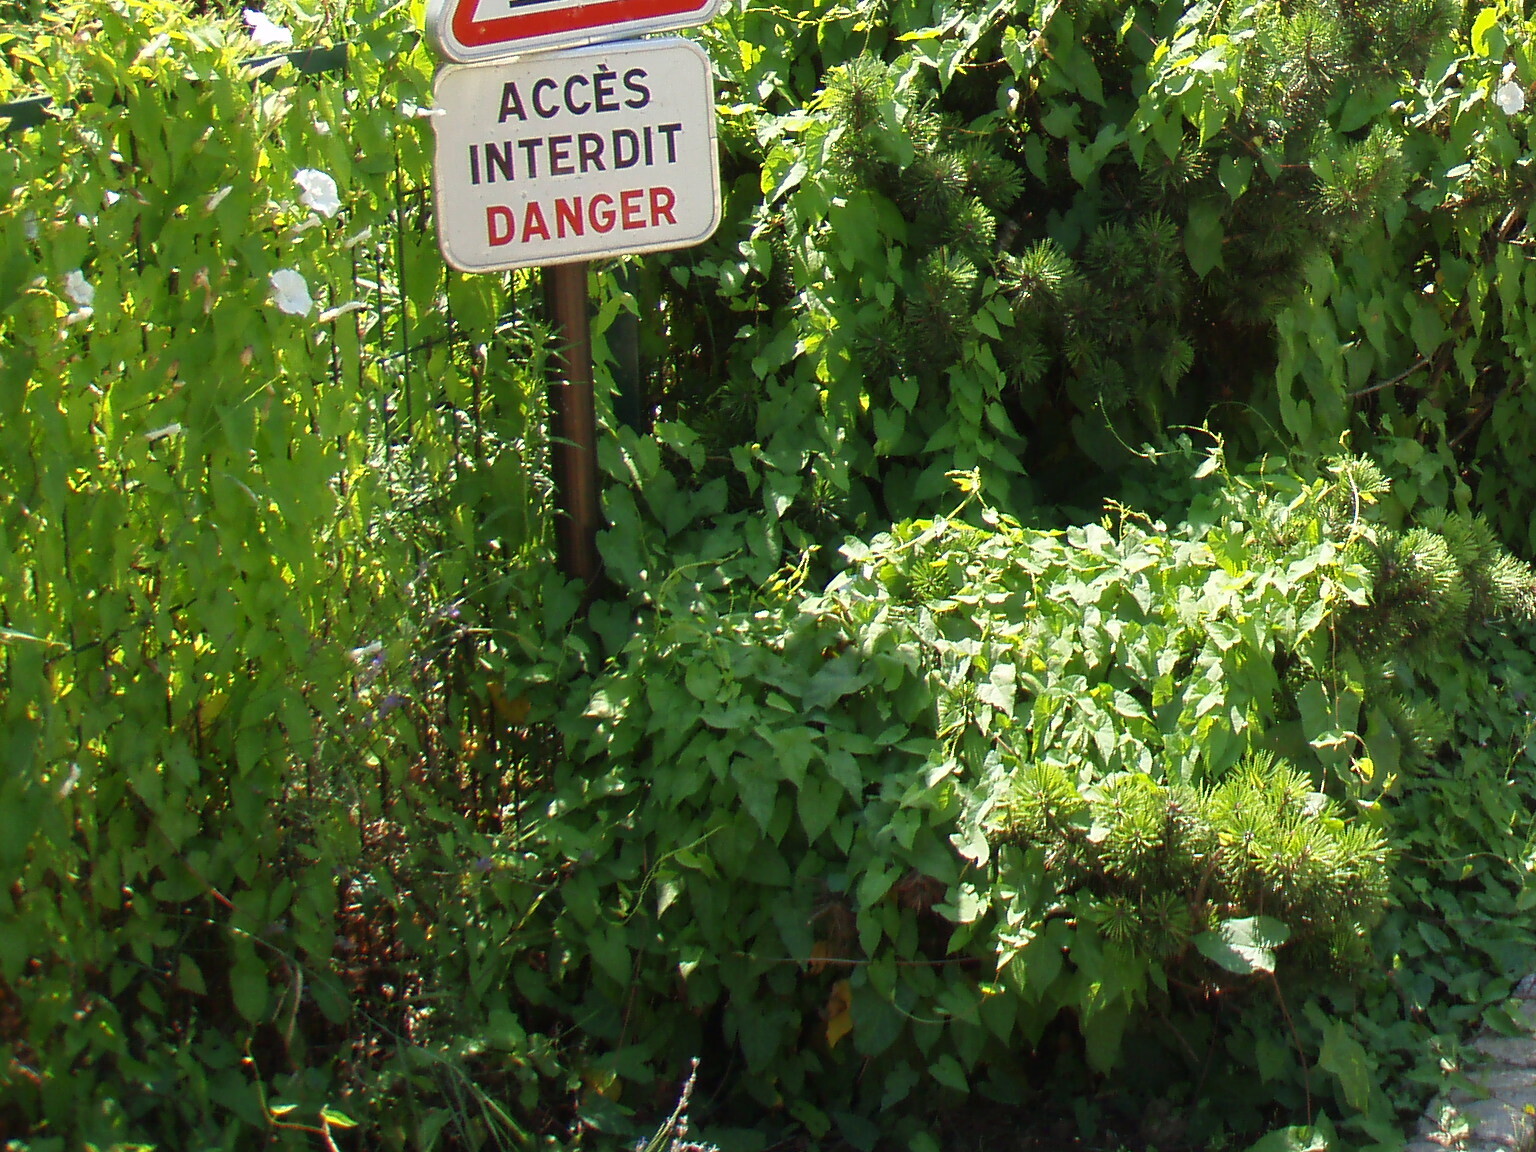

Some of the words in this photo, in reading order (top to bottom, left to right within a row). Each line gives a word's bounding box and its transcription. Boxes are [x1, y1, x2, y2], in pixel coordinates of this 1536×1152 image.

[498, 64, 650, 123] ACCÈS
[469, 123, 682, 185] INTERDIT
[487, 186, 677, 247] DANGER
